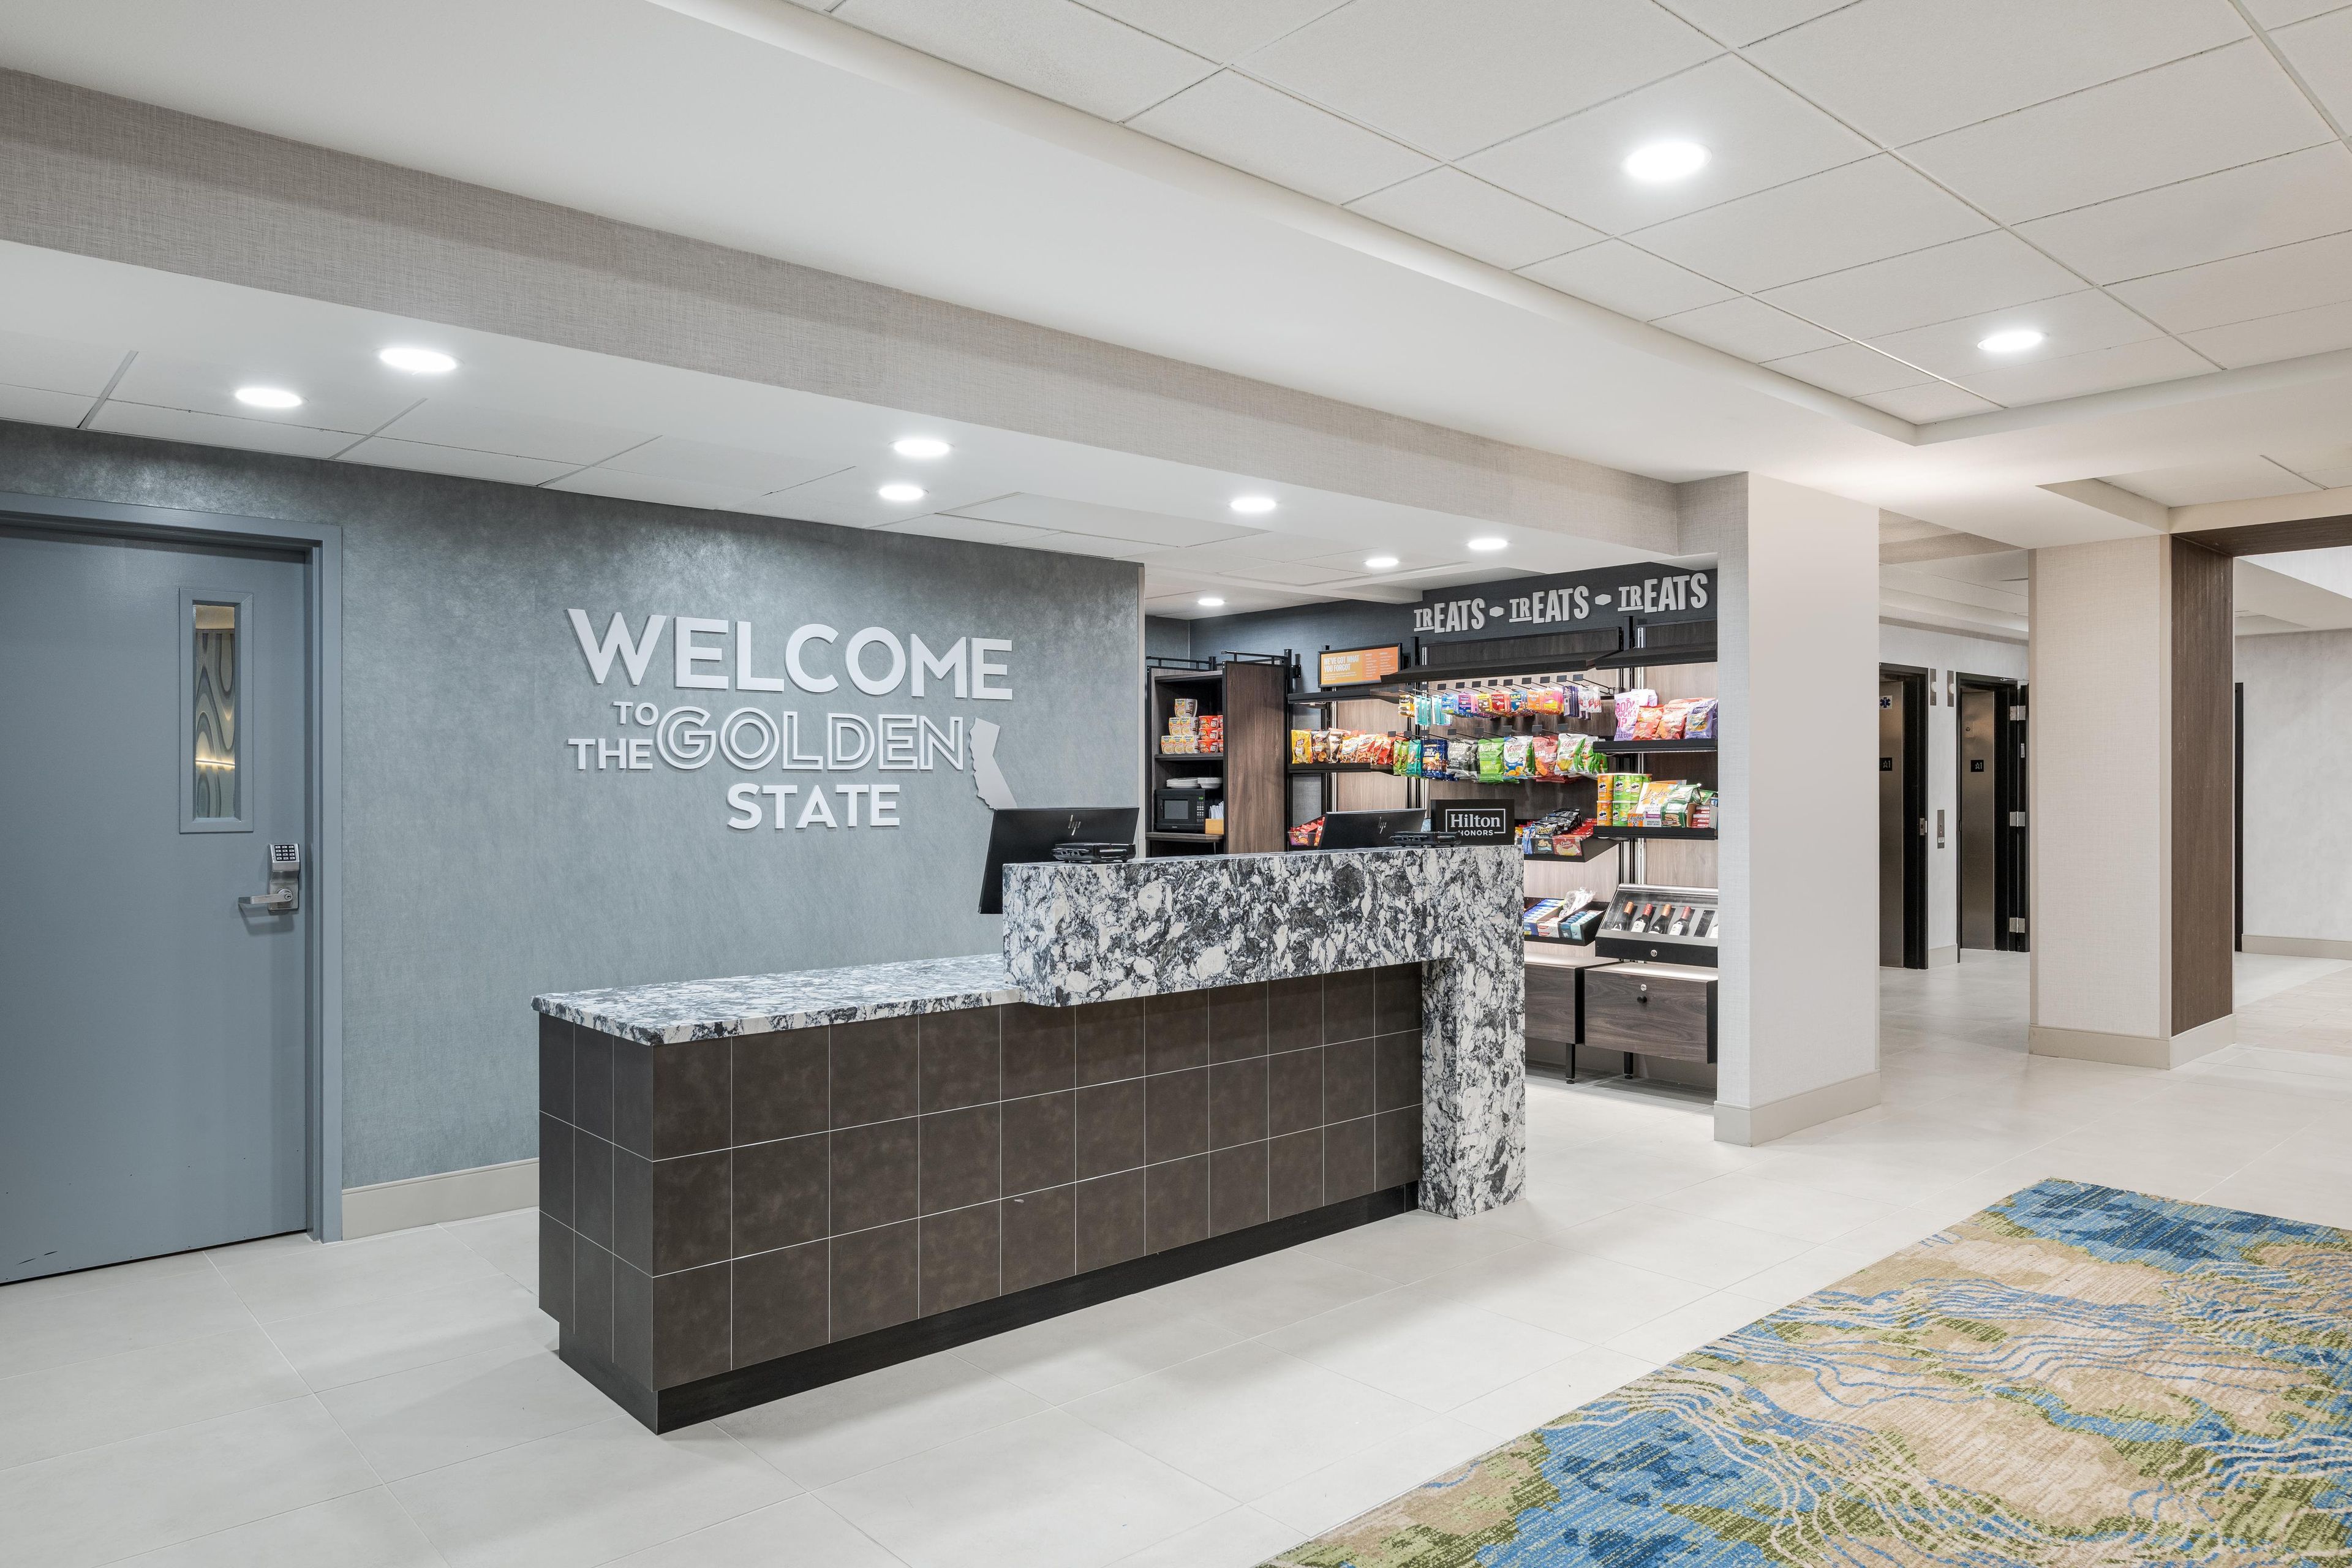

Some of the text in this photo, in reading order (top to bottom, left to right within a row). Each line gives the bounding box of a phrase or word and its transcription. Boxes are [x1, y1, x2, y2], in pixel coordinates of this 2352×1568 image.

[1414, 573, 1708, 633] TREATS TREATS TREATS
[567, 608, 1013, 699] WELCOME
[568, 706, 963, 770] THE GOLDEN
[613, 701, 658, 726] TO
[727, 783, 900, 829] STATE
[1450, 813, 1501, 827] Hilton
